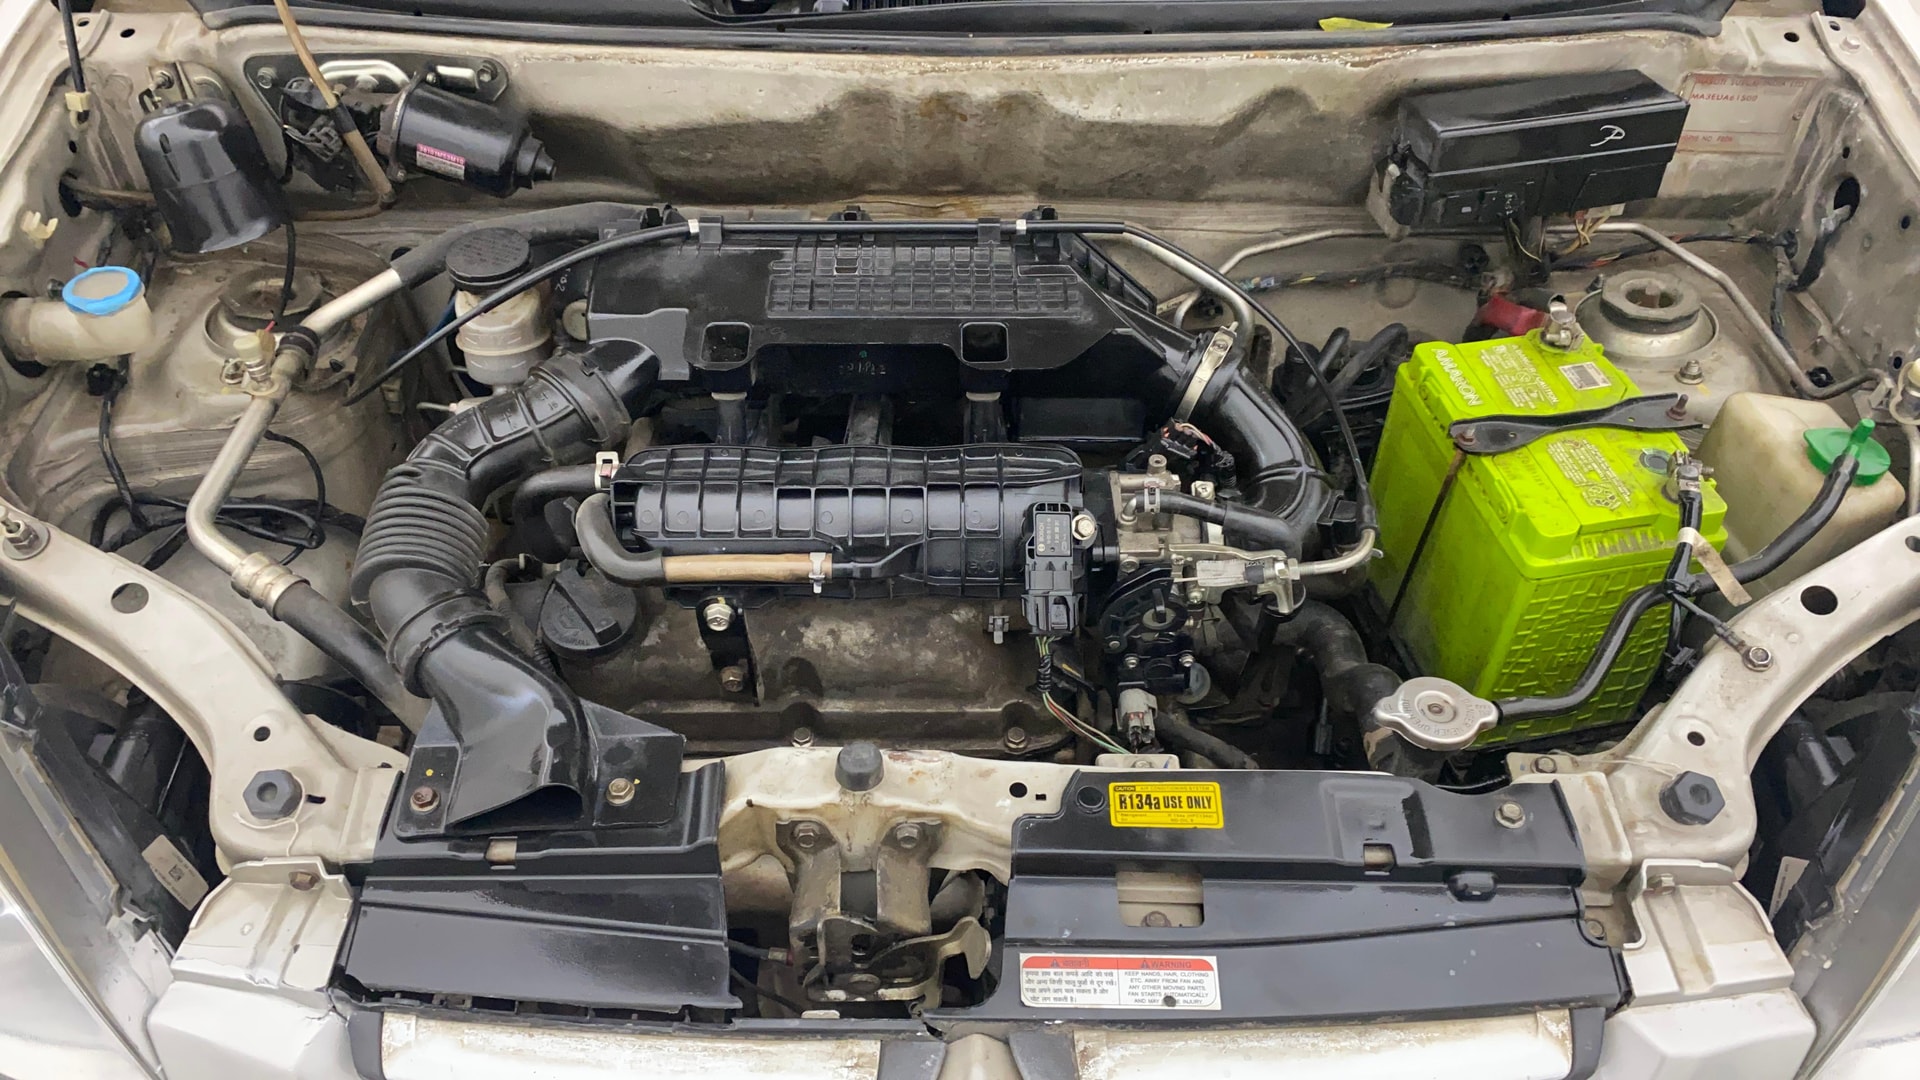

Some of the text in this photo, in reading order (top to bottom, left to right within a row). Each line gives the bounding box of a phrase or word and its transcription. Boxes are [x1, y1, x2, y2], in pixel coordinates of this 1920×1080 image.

[1118, 794, 1212, 810] R134a USE ONLY
